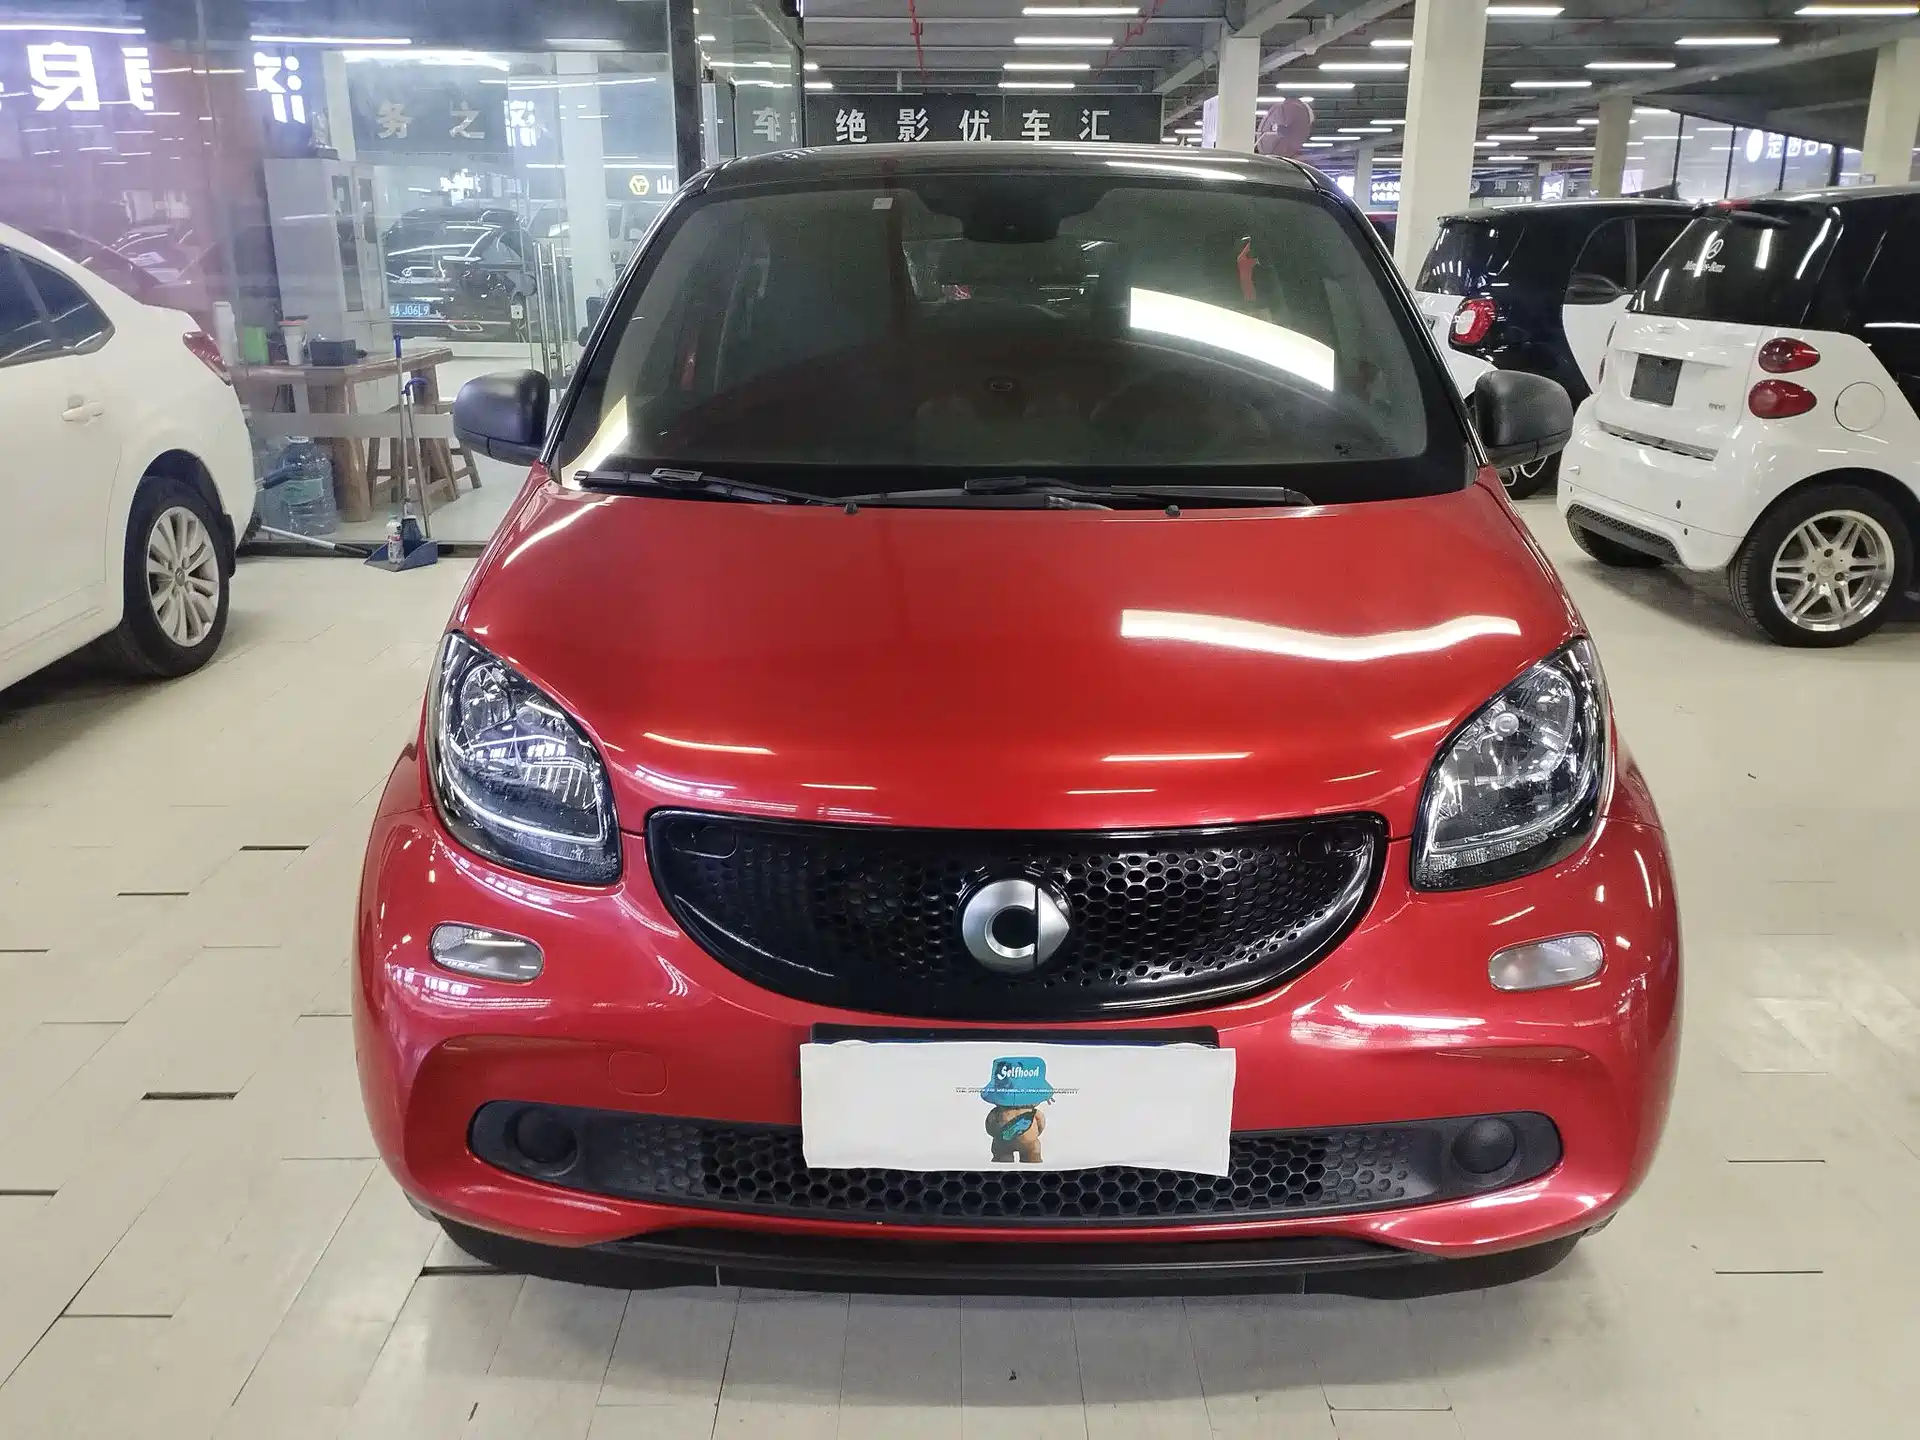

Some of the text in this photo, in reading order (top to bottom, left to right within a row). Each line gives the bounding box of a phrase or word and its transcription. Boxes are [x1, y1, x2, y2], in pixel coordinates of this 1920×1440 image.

[835, 107, 1111, 143] 绝影优车汇
[997, 1066, 1040, 1080] Selfhood
